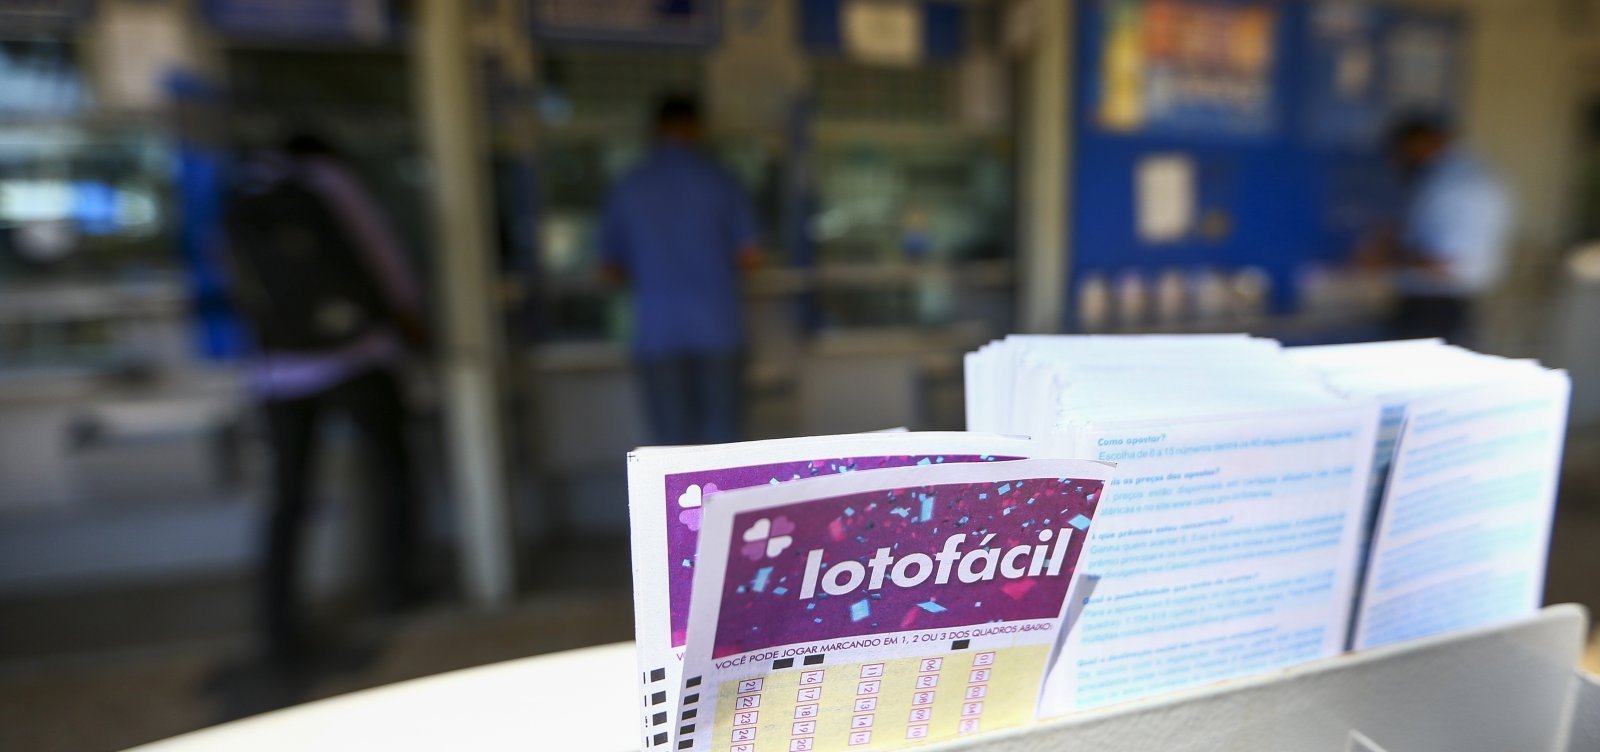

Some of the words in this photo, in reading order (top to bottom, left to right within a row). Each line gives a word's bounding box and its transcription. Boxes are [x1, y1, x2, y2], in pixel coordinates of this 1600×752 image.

[1097, 437, 1124, 447] Como
[1125, 433, 1166, 446] apostar?
[1098, 449, 1136, 461] Escolha
[1136, 450, 1148, 459] de
[1135, 475, 1164, 486] preços
[799, 528, 1073, 600] lotofácil
[716, 655, 746, 670] VOCÊ
[749, 650, 779, 663] PODE
[781, 645, 818, 658] JOGAR
[820, 638, 881, 653] MARCANDO
[884, 637, 898, 646] EM
[902, 636, 909, 645] 1,
[912, 635, 919, 643] 2
[921, 633, 938, 642] OU
[940, 632, 947, 640] 3
[949, 630, 970, 639] DOS
[972, 625, 1017, 637] QUADROS
[980, 654, 989, 664] 01
[926, 659, 936, 671] 06
[867, 667, 878, 676] 11
[806, 672, 818, 683] 16
[923, 676, 933, 687] 07
[745, 681, 756, 691] 21
[863, 683, 874, 693] 12
[804, 689, 815, 699] 17
[742, 696, 754, 708] 22
[860, 700, 871, 710] 13
[801, 706, 812, 717] 18
[740, 713, 751, 724] 23
[858, 717, 868, 726] 14
[799, 723, 809, 733] 19
[739, 729, 749, 740] 24
[796, 739, 807, 750] 20
